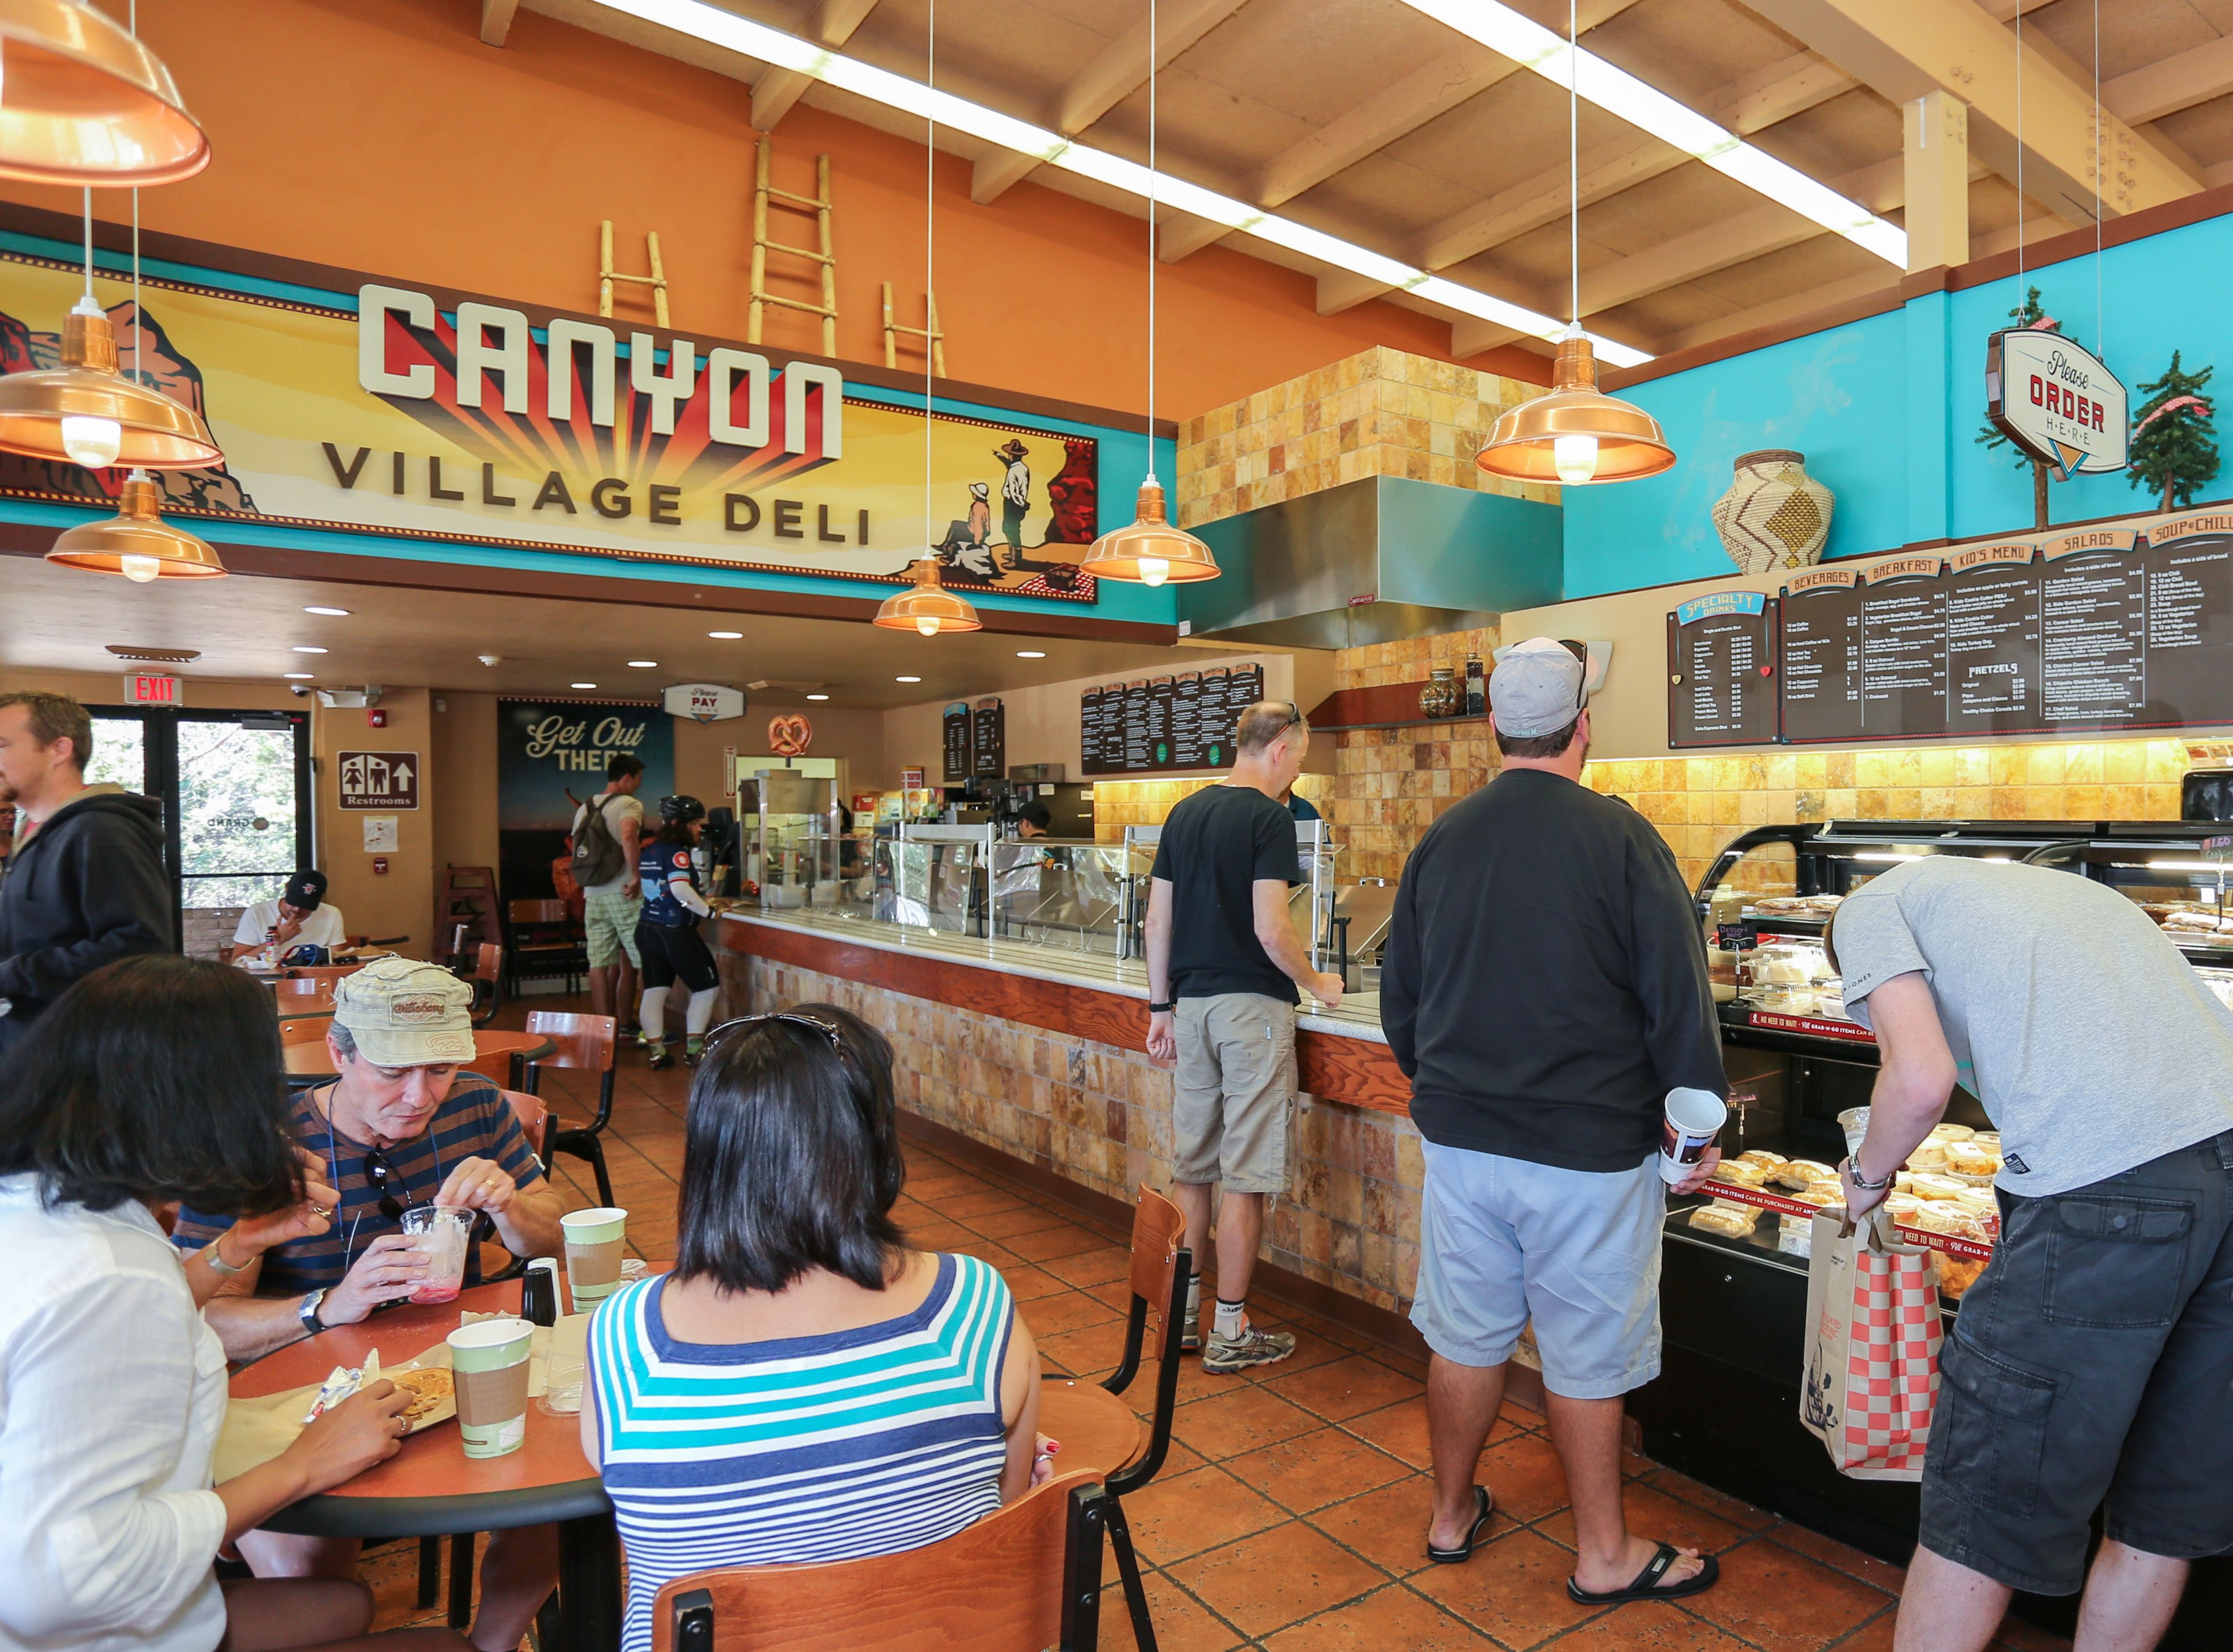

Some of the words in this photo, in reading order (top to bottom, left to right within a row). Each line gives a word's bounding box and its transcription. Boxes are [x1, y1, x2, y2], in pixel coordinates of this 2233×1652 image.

[358, 283, 843, 460] CANYON
[2047, 350, 2089, 389] Please
[2030, 374, 2104, 433] ORDER
[322, 442, 681, 526] VILLAGE
[725, 493, 869, 545] DELI
[2157, 522, 2187, 541] SOUP
[2065, 533, 2113, 550] SALADS
[1960, 550, 1986, 567] KID'S
[1993, 547, 2024, 559] MENU
[1874, 560, 1932, 579] BREAKFAST
[1795, 572, 1849, 590] BEVERAGES
[1688, 594, 1753, 618] SPECIALTY
[1703, 605, 1736, 616] DRINKS
[1968, 663, 2018, 678] PRETZELS
[136, 677, 174, 701] EXIT
[692, 697, 717, 707] PAY
[526, 716, 587, 758] Get
[592, 717, 645, 746] Out
[553, 750, 634, 770] THER
[347, 796, 411, 805] Restrooms
[1779, 1018, 1784, 1026] TO
[1785, 1019, 1797, 1027] WAIT!
[1764, 1199, 1794, 1210] PURCHASED
[1905, 1232, 1918, 1242] NEED
[1920, 1235, 1927, 1244] TO
[1929, 1237, 1944, 1248] WAIT!
